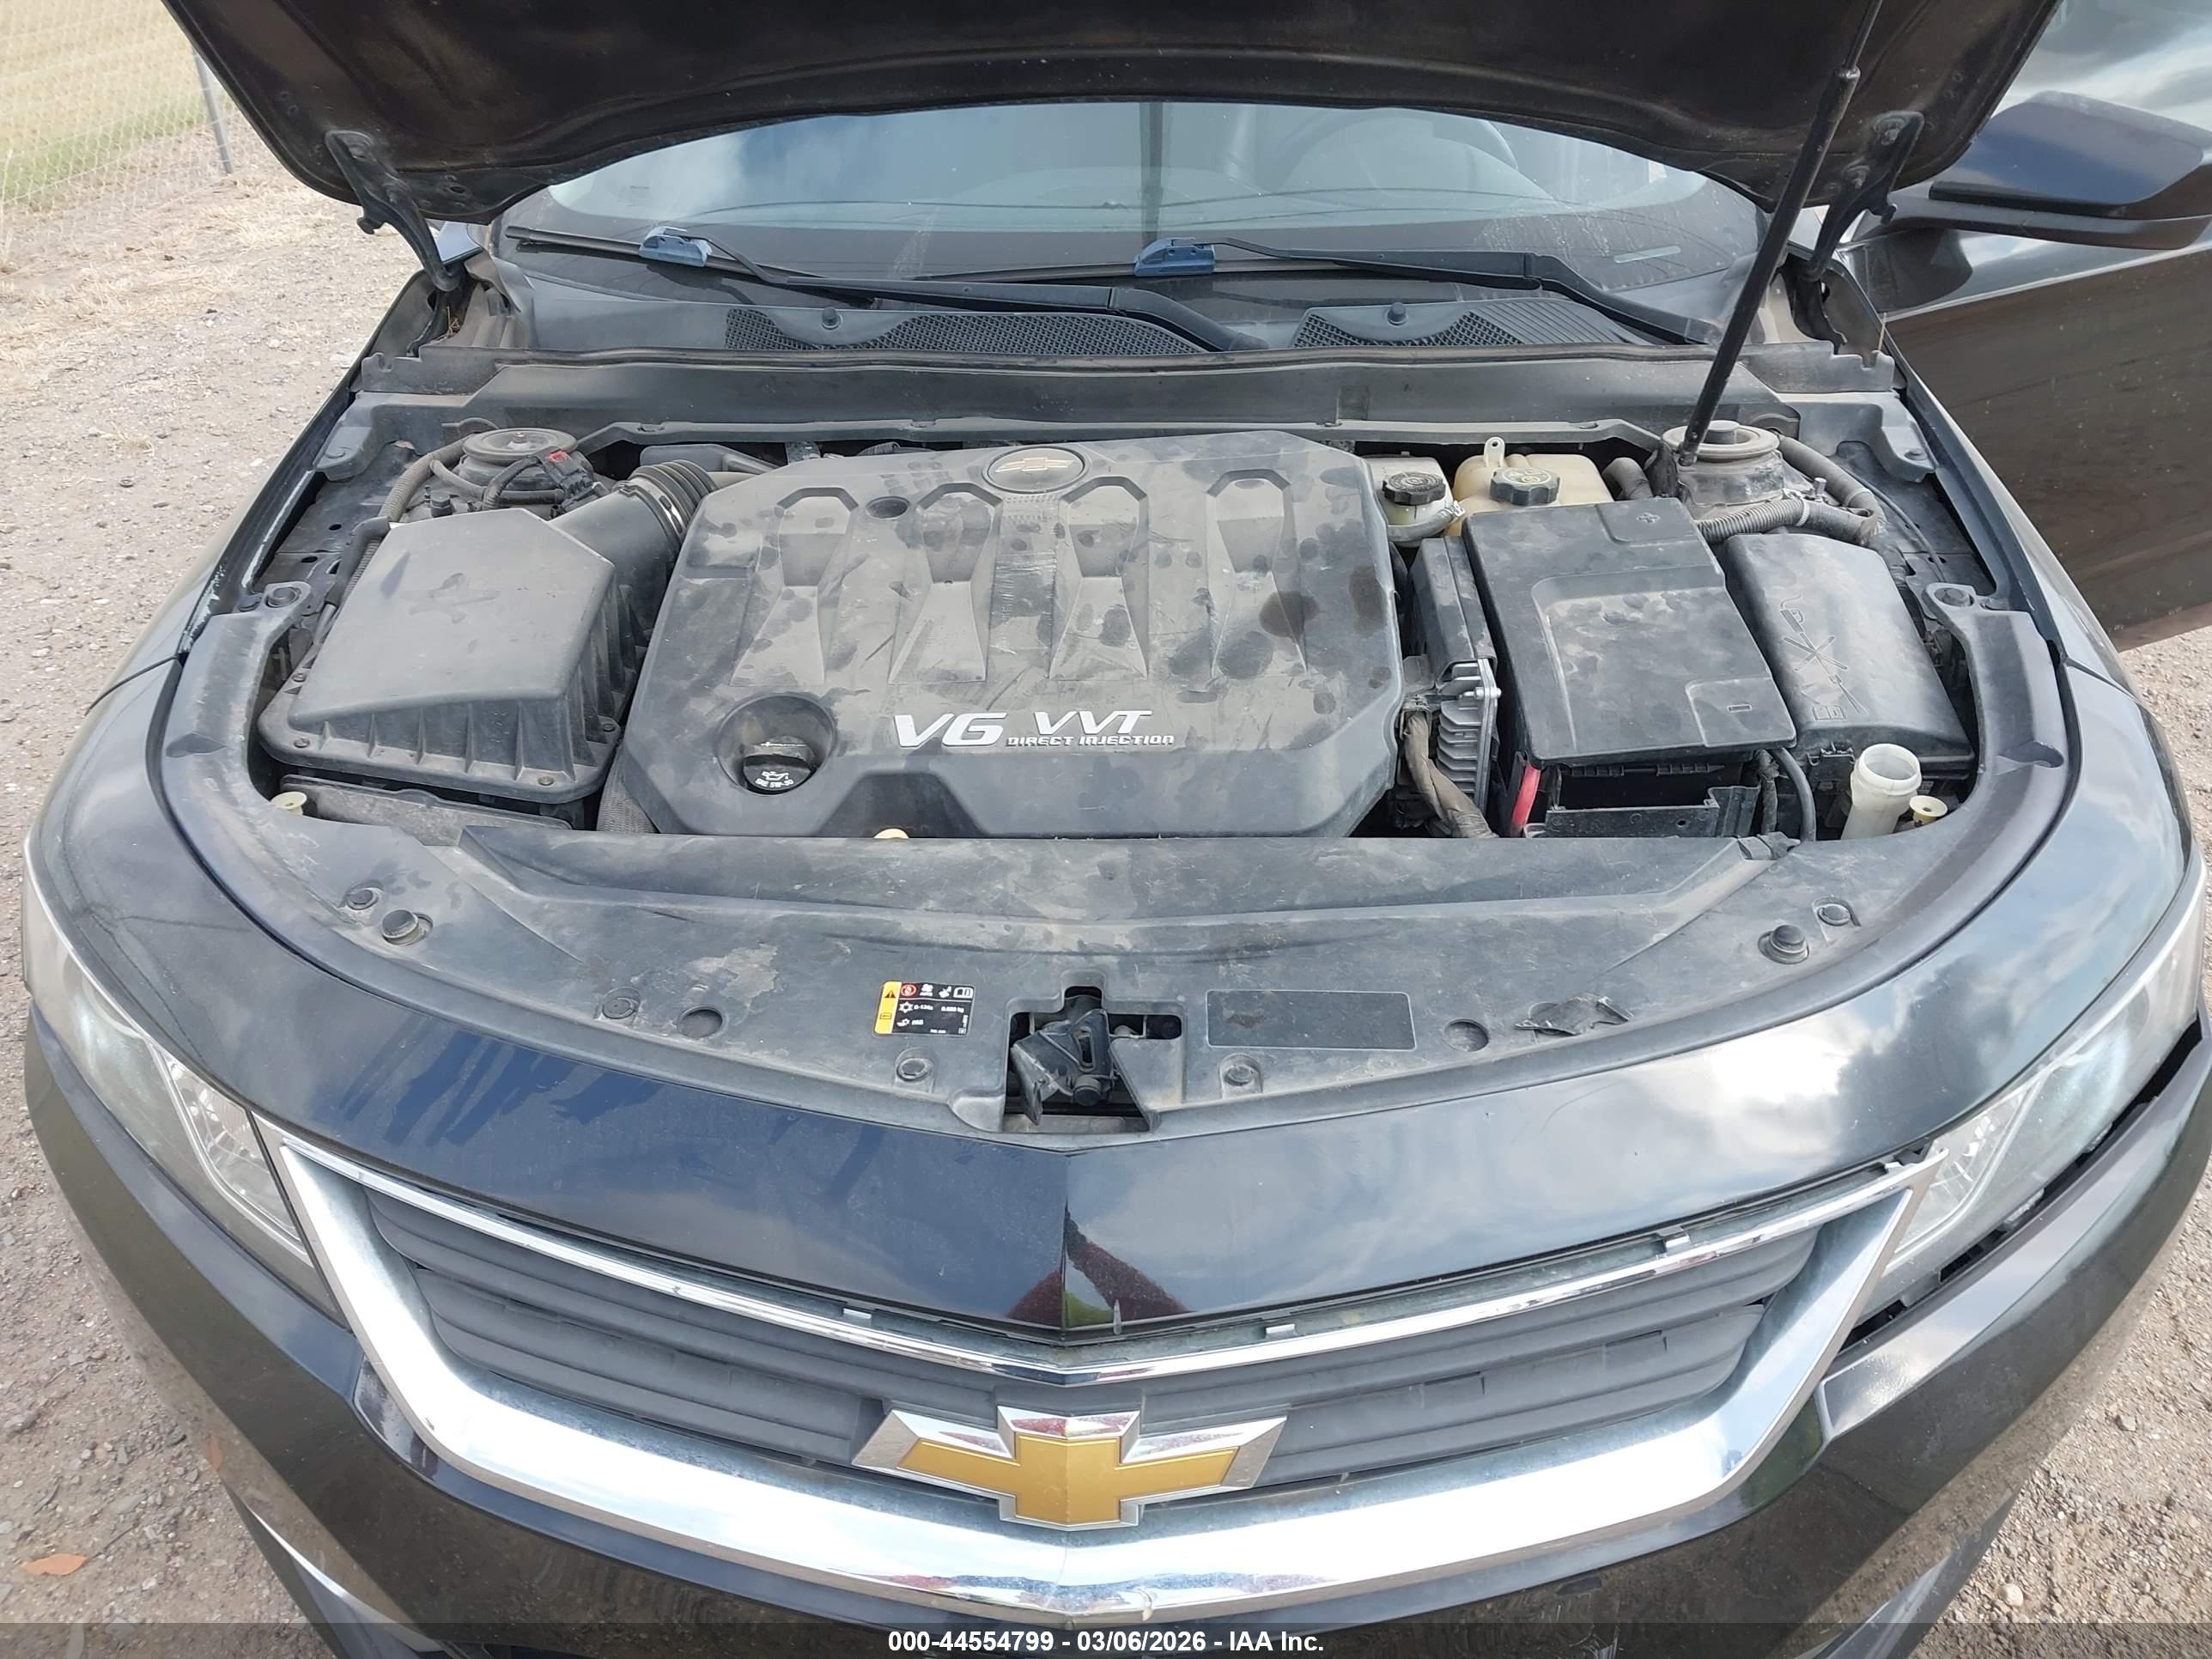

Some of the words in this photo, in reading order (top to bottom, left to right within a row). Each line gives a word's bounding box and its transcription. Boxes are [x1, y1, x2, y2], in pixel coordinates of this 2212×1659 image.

[894, 712, 1007, 748] V6
[1034, 710, 1153, 736] VVT
[1006, 735, 1074, 747] DIRECT
[1079, 734, 1175, 746] INJECTION
